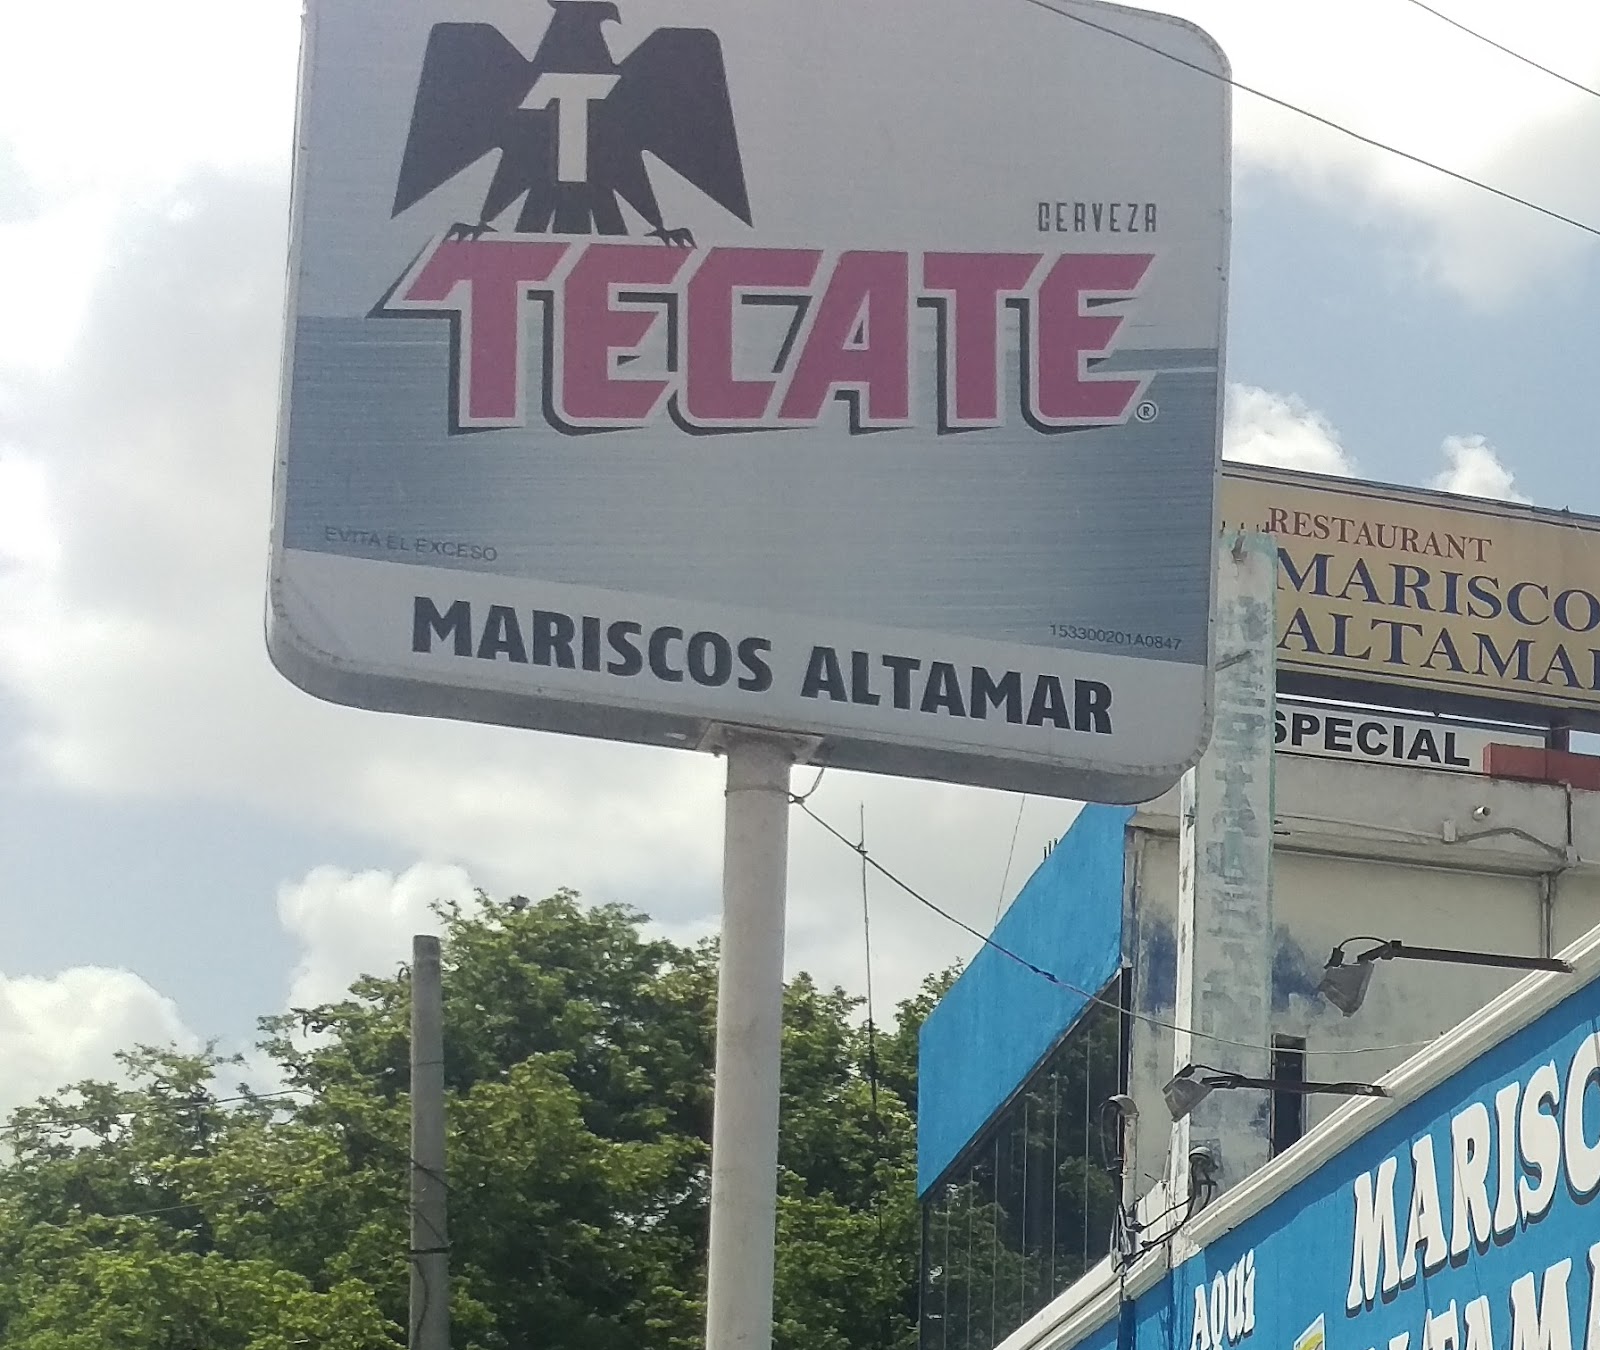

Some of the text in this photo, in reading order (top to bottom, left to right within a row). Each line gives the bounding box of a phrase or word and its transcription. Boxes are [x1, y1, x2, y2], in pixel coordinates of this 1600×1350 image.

[1037, 200, 1159, 235] CERVEZA
[375, 236, 1156, 434] TECATE
[324, 525, 498, 562] EVITA EL EXCESO
[1267, 507, 1493, 563] RESTAURANT
[1049, 624, 1182, 651] 153300201A0847
[412, 595, 1113, 734] MARISCOS ALTAMAR
